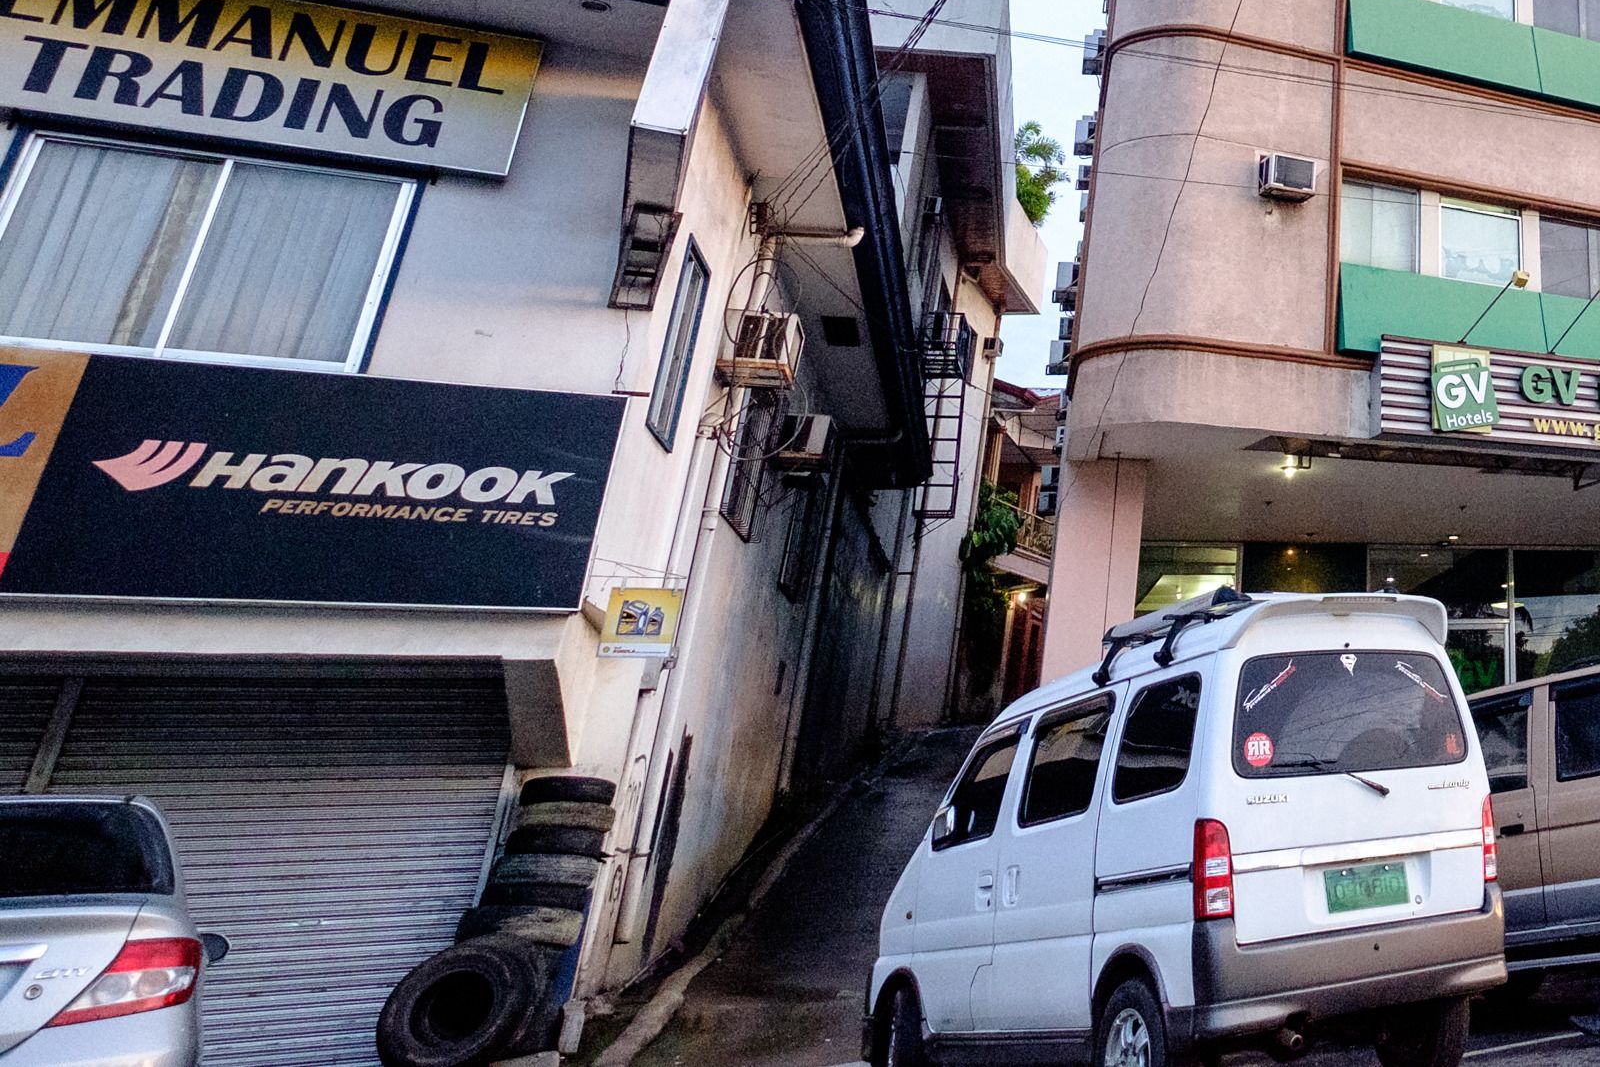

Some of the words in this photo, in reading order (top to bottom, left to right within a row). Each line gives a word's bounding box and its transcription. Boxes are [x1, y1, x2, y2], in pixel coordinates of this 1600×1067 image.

[22, 35, 444, 149] TRADING
[1437, 370, 1489, 409] GV
[1520, 365, 1582, 406] GV
[1445, 411, 1494, 429] Hotels
[259, 497, 474, 524] PERFORMANCE
[481, 509, 559, 527] TIRES
[1247, 793, 1289, 805] SUZUKI
[34, 965, 93, 981] CITY
